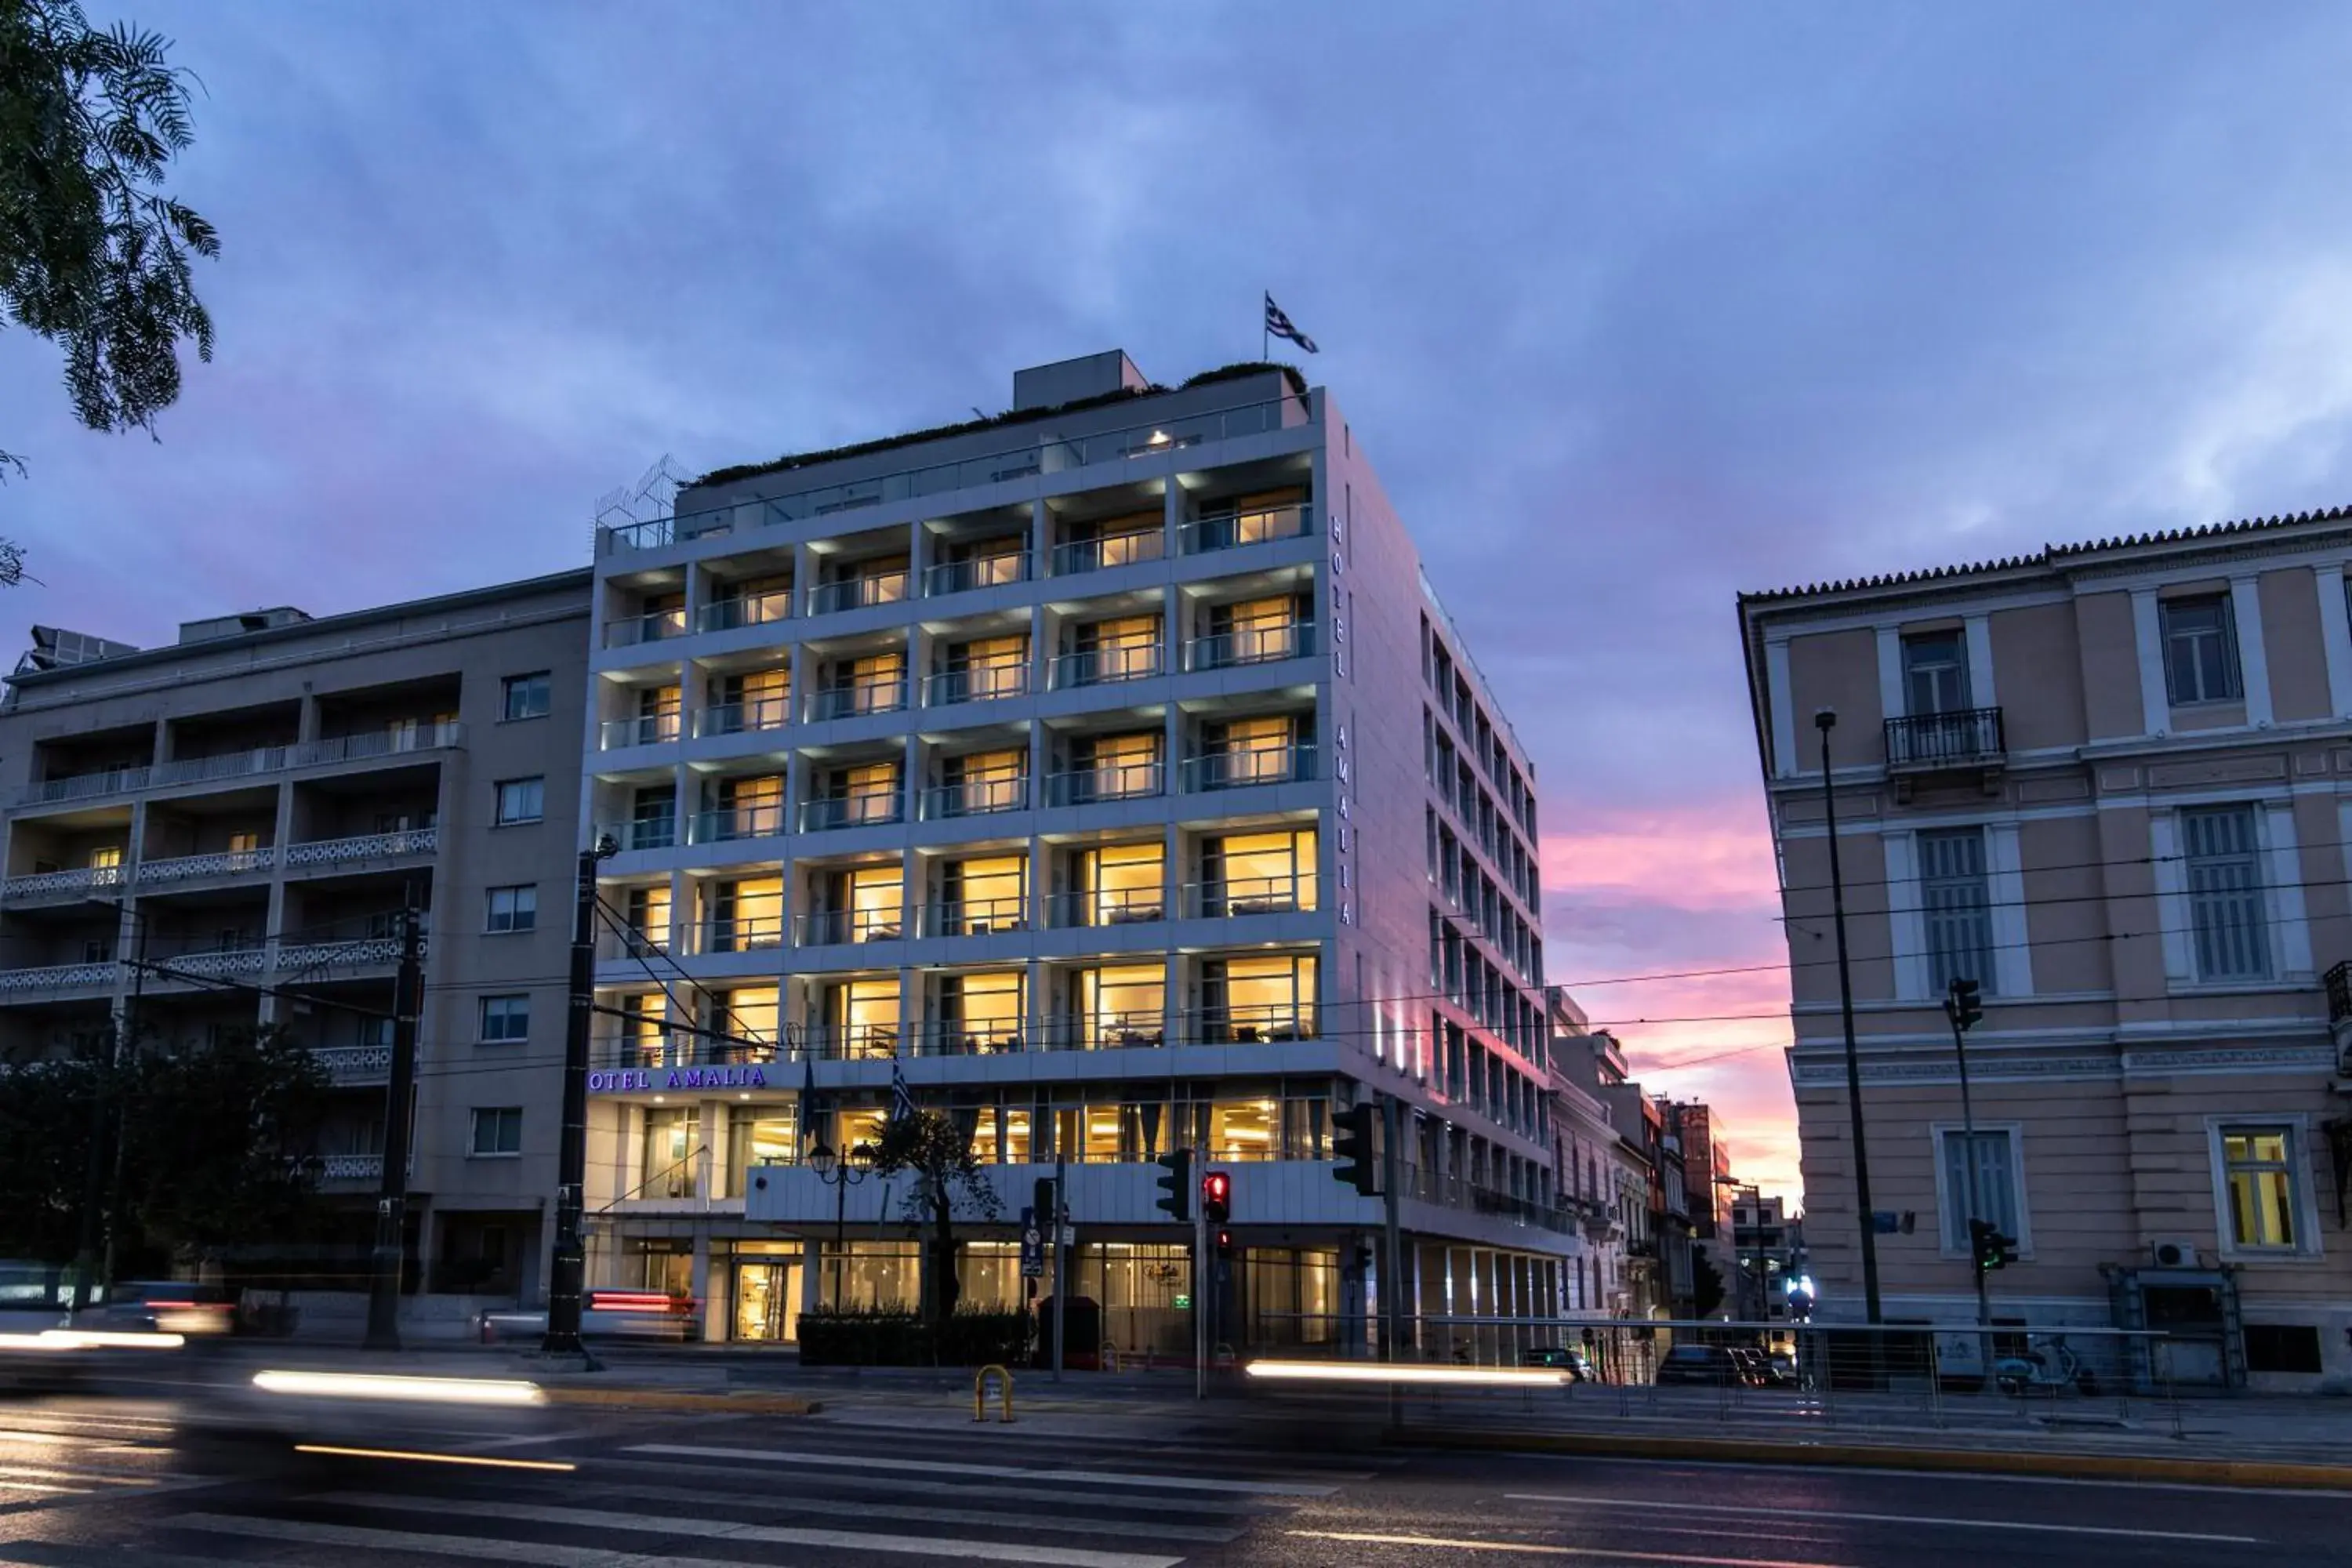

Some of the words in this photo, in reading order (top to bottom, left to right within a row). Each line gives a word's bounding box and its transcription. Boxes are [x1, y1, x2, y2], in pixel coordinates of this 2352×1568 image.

[1332, 515, 1345, 678] HOTEL
[1336, 725, 1350, 926] AMALIA
[589, 1071, 650, 1091] OTEL
[666, 1066, 767, 1087] AMALIA
